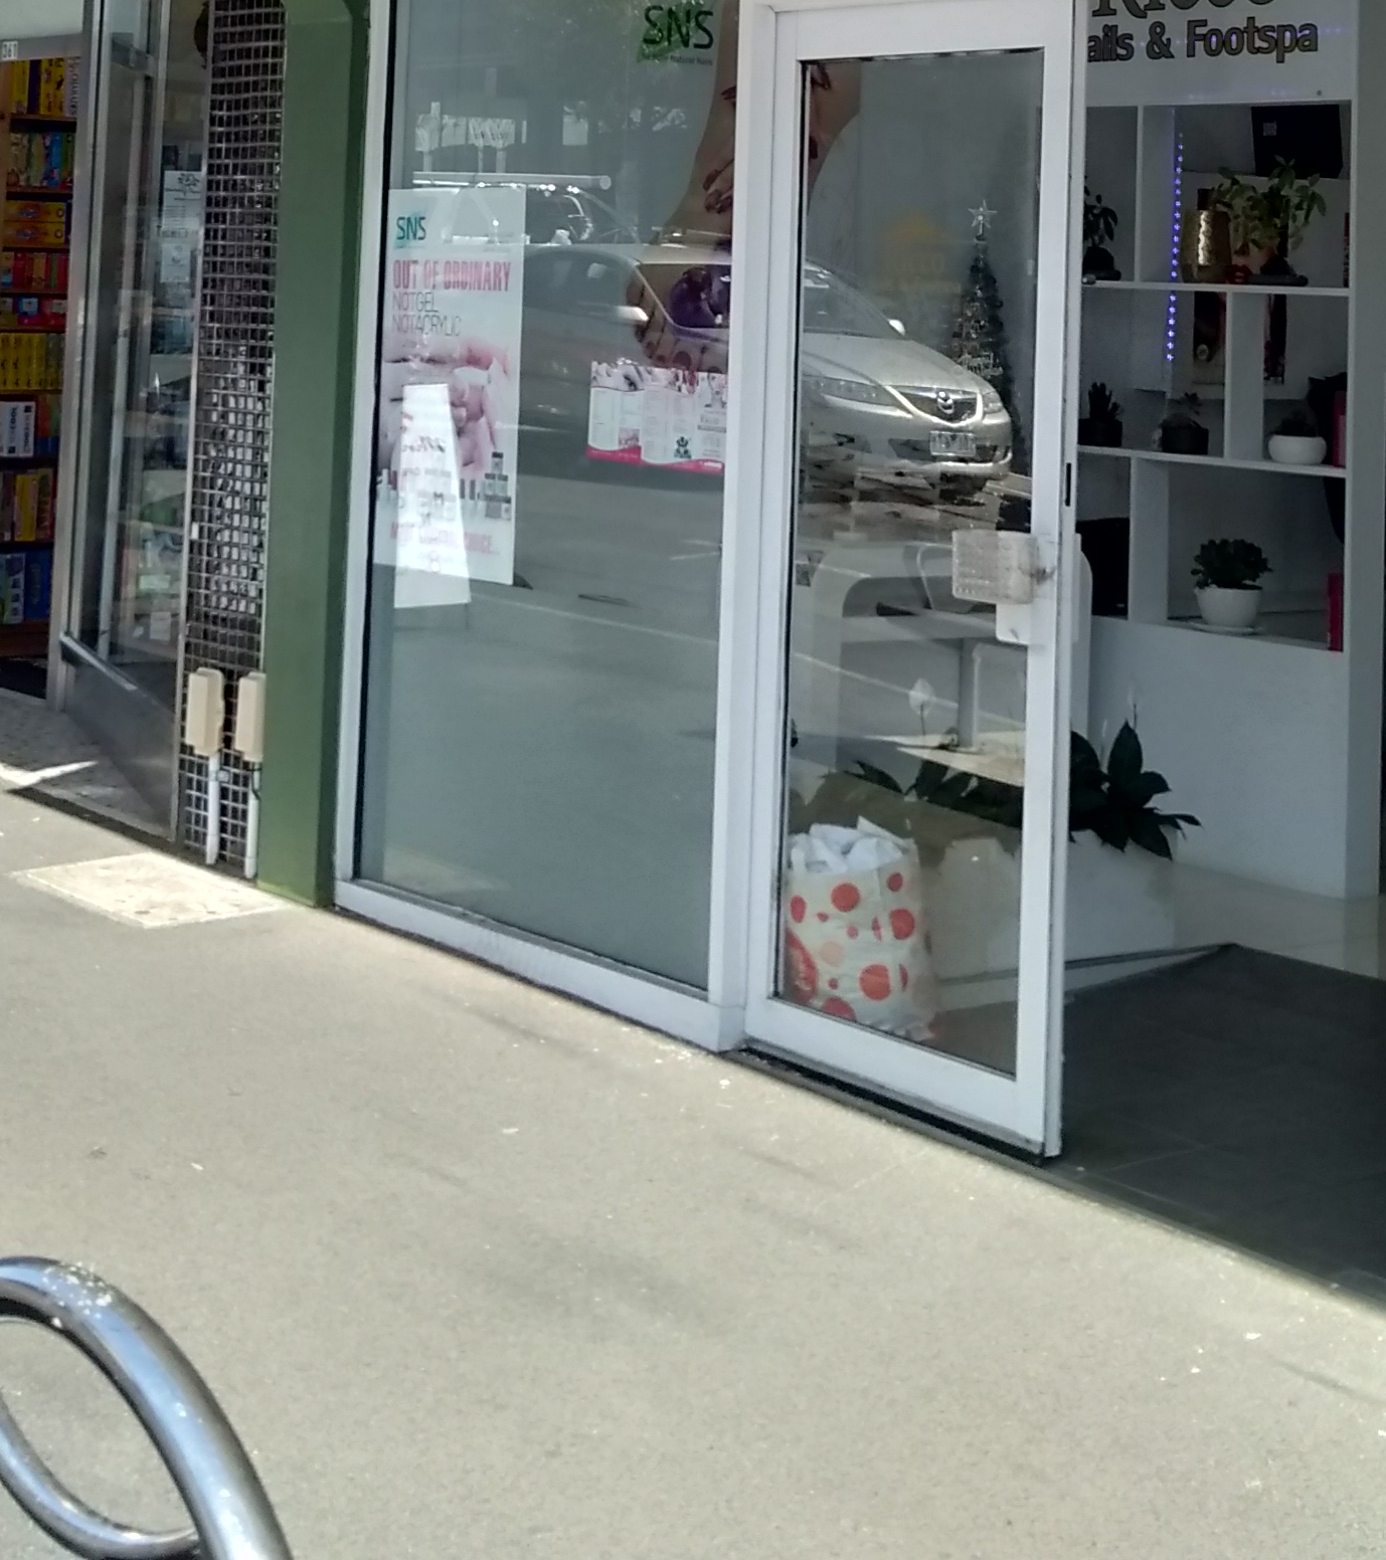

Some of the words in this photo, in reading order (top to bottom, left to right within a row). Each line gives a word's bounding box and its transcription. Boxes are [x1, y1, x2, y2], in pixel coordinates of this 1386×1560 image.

[643, 5, 713, 49] SNS
[1086, 25, 1134, 64] ails
[1146, 25, 1174, 60] &
[1186, 16, 1320, 64] Footspa
[396, 216, 426, 240] SNS
[393, 260, 419, 289] OUT
[424, 261, 439, 290] OF
[443, 261, 511, 292] ORDINARY
